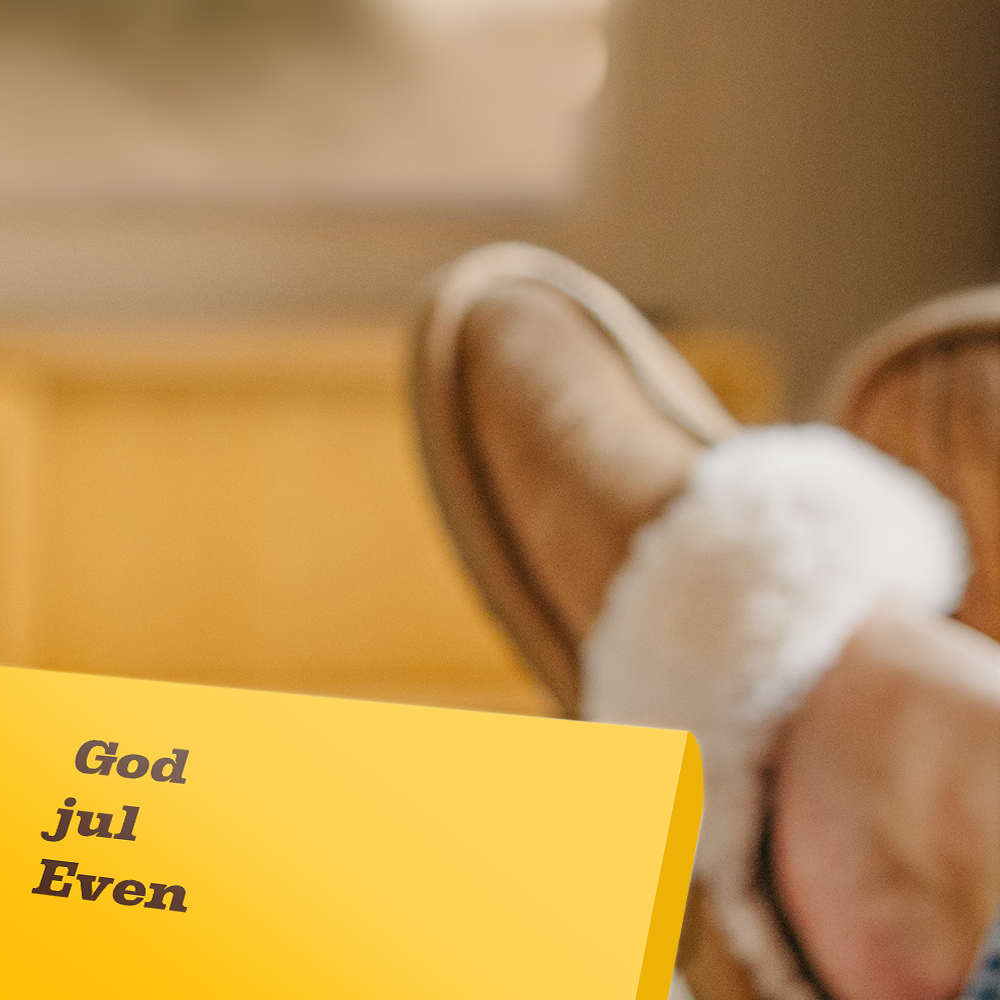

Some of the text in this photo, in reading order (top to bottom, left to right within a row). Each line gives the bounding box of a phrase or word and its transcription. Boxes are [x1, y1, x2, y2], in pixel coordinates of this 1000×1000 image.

[75, 739, 190, 785] God
[40, 797, 140, 842] jul
[31, 858, 188, 913] Even
